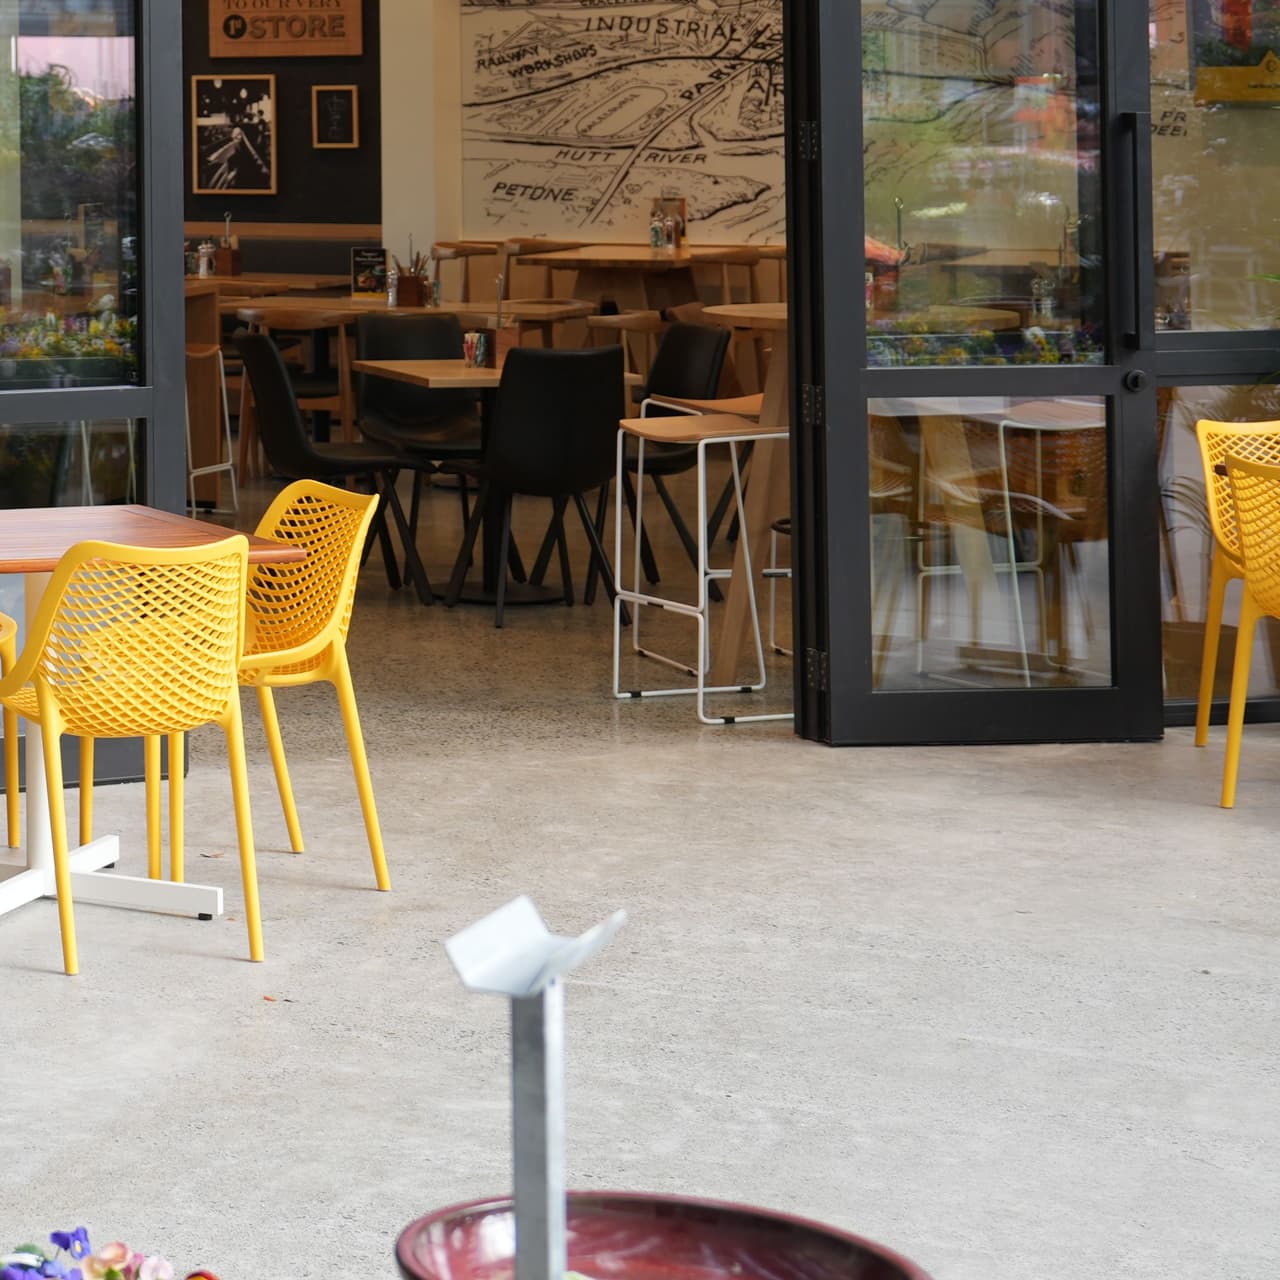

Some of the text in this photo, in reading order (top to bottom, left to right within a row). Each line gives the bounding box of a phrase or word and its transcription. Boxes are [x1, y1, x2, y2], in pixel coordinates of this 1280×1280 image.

[224, 0, 248, 10] TO
[249, 15, 346, 39] STORE
[555, 150, 708, 165] HUTT RIVER
[492, 181, 578, 202] PETONE
